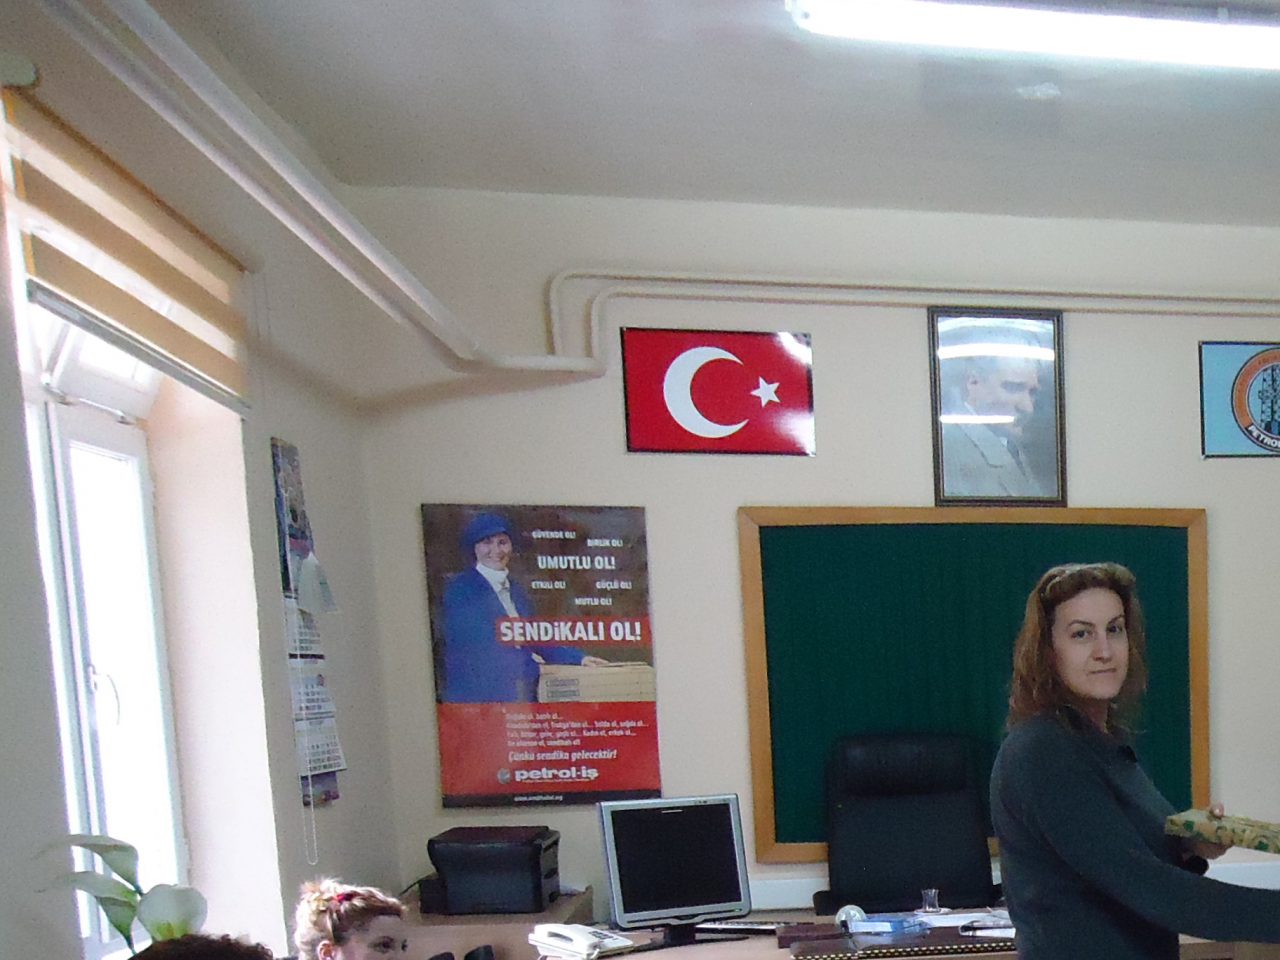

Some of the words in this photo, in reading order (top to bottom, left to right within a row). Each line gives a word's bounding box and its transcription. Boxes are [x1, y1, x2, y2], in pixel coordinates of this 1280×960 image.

[537, 555, 591, 570] UMUTLU
[594, 556, 616, 570] OL!
[575, 597, 599, 606] MUTLU
[610, 621, 642, 642] OL!
[537, 750, 569, 760] sendika
[571, 749, 617, 762] gelecektir!
